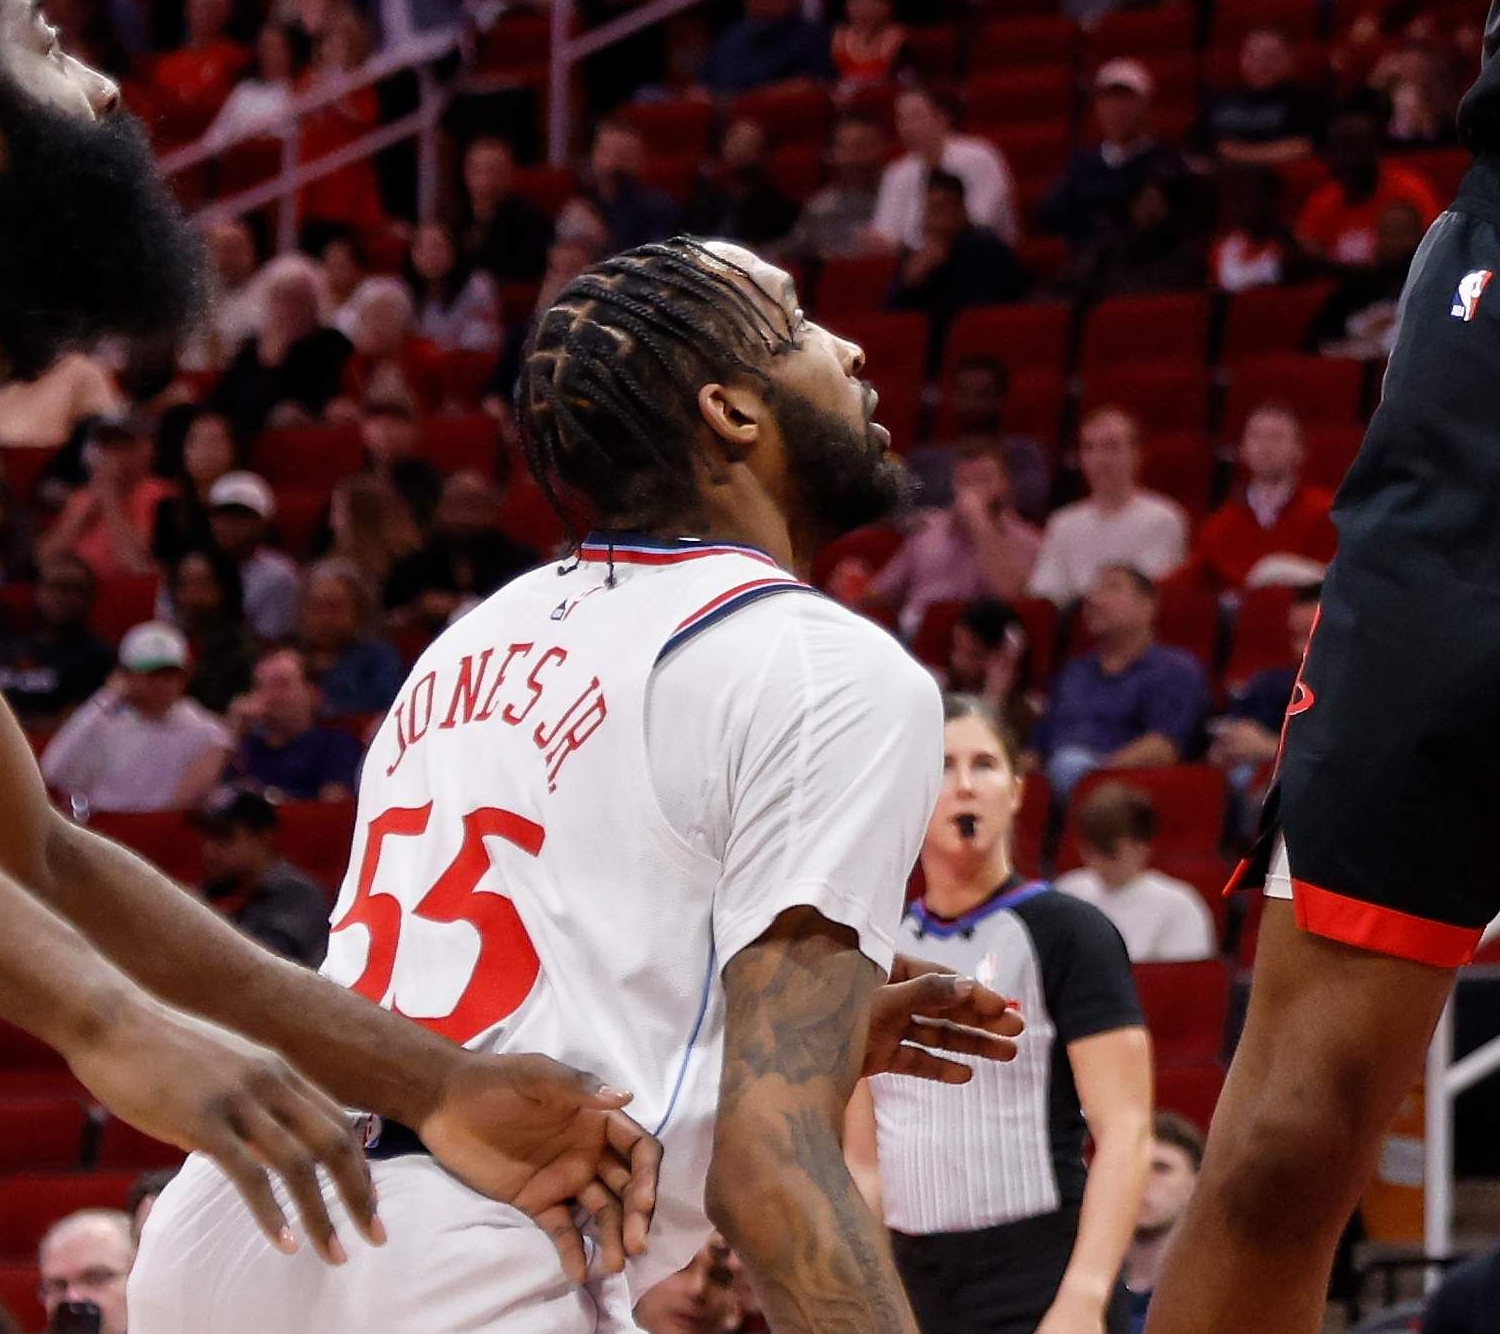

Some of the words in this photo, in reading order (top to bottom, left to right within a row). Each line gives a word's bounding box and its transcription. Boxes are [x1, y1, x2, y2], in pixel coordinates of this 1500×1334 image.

[386, 641, 568, 778] JONES
[532, 675, 608, 795] JR.
[329, 799, 546, 1050] 55
